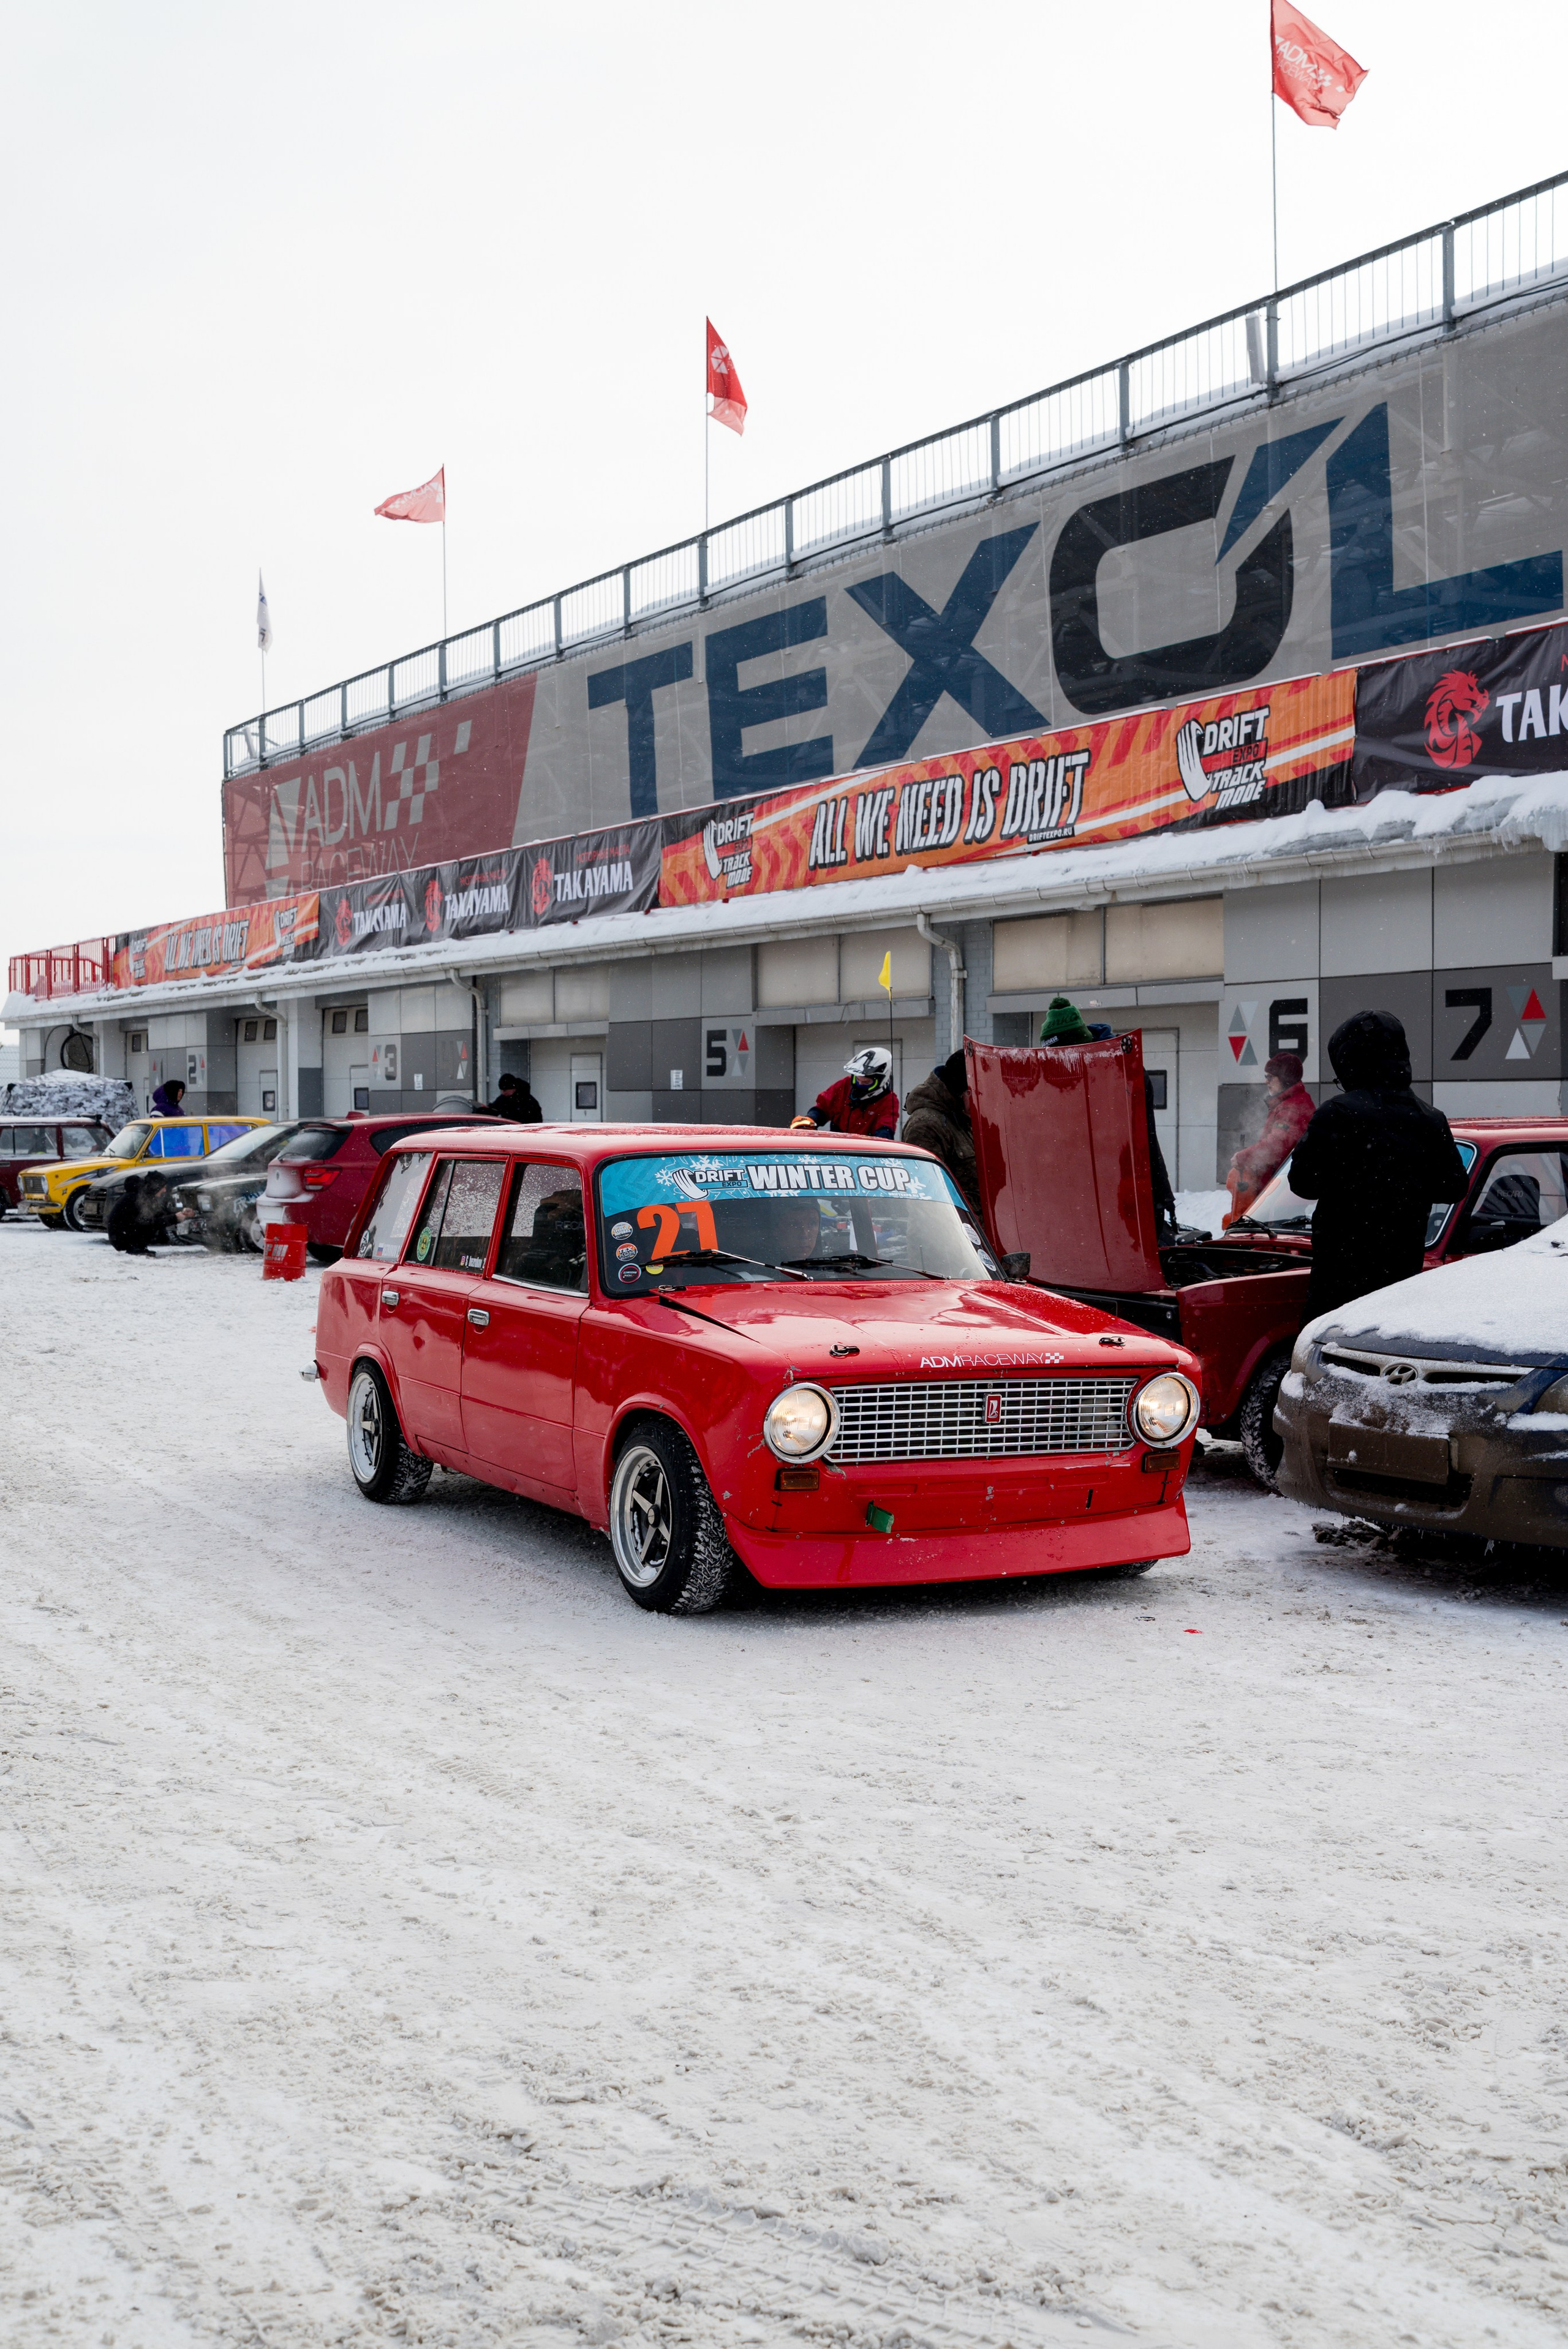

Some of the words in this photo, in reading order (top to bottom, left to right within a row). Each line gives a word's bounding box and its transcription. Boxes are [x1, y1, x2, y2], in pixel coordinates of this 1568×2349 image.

[1276, 40, 1317, 75] ADM
[1203, 706, 1270, 755] DRIFT
[1232, 744, 1259, 763] EXPO
[301, 751, 381, 853] ADM
[809, 797, 848, 870] ALL
[855, 786, 895, 861] WE
[895, 774, 965, 856] NEED
[963, 766, 1002, 845] IS
[1001, 748, 1090, 840] DRIFT
[1215, 779, 1267, 810] MODE
[717, 812, 754, 846] DRIFT
[1028, 827, 1074, 842] DRIFTEXPO.RU
[554, 861, 633, 902] TAKAYAMA
[353, 903, 407, 935] TAKAYAMA
[445, 884, 509, 921] TAKAYAMA
[165, 933, 178, 973] ALL
[178, 930, 192, 970] WE
[222, 919, 249, 962] DRIFT
[1268, 998, 1308, 1065] 6
[1445, 987, 1493, 1061] 7
[188, 1055, 197, 1084] 2
[385, 1044, 397, 1080] 3
[706, 1030, 727, 1077] 5
[695, 1167, 745, 1183] DRIFT
[746, 1164, 857, 1191] WINTER
[856, 1165, 911, 1193] CUP
[1496, 1190, 1524, 1198] RECARO
[637, 1200, 718, 1261] 27
